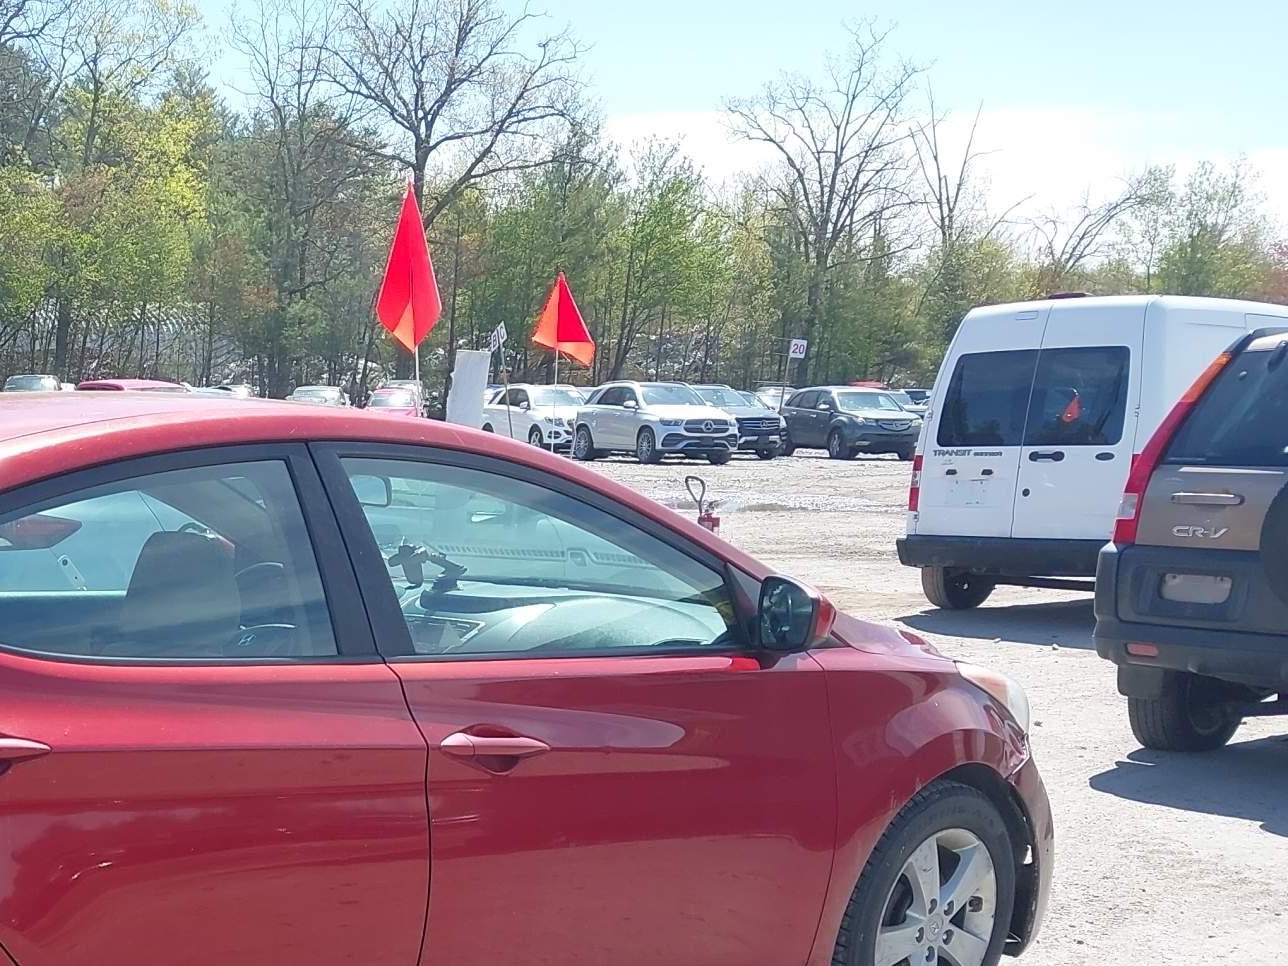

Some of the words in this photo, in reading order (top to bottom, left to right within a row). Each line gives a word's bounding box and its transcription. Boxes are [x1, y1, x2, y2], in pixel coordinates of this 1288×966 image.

[792, 343, 805, 355] 20
[933, 448, 972, 457] TRANSIT
[1172, 525, 1229, 538] CR-V
